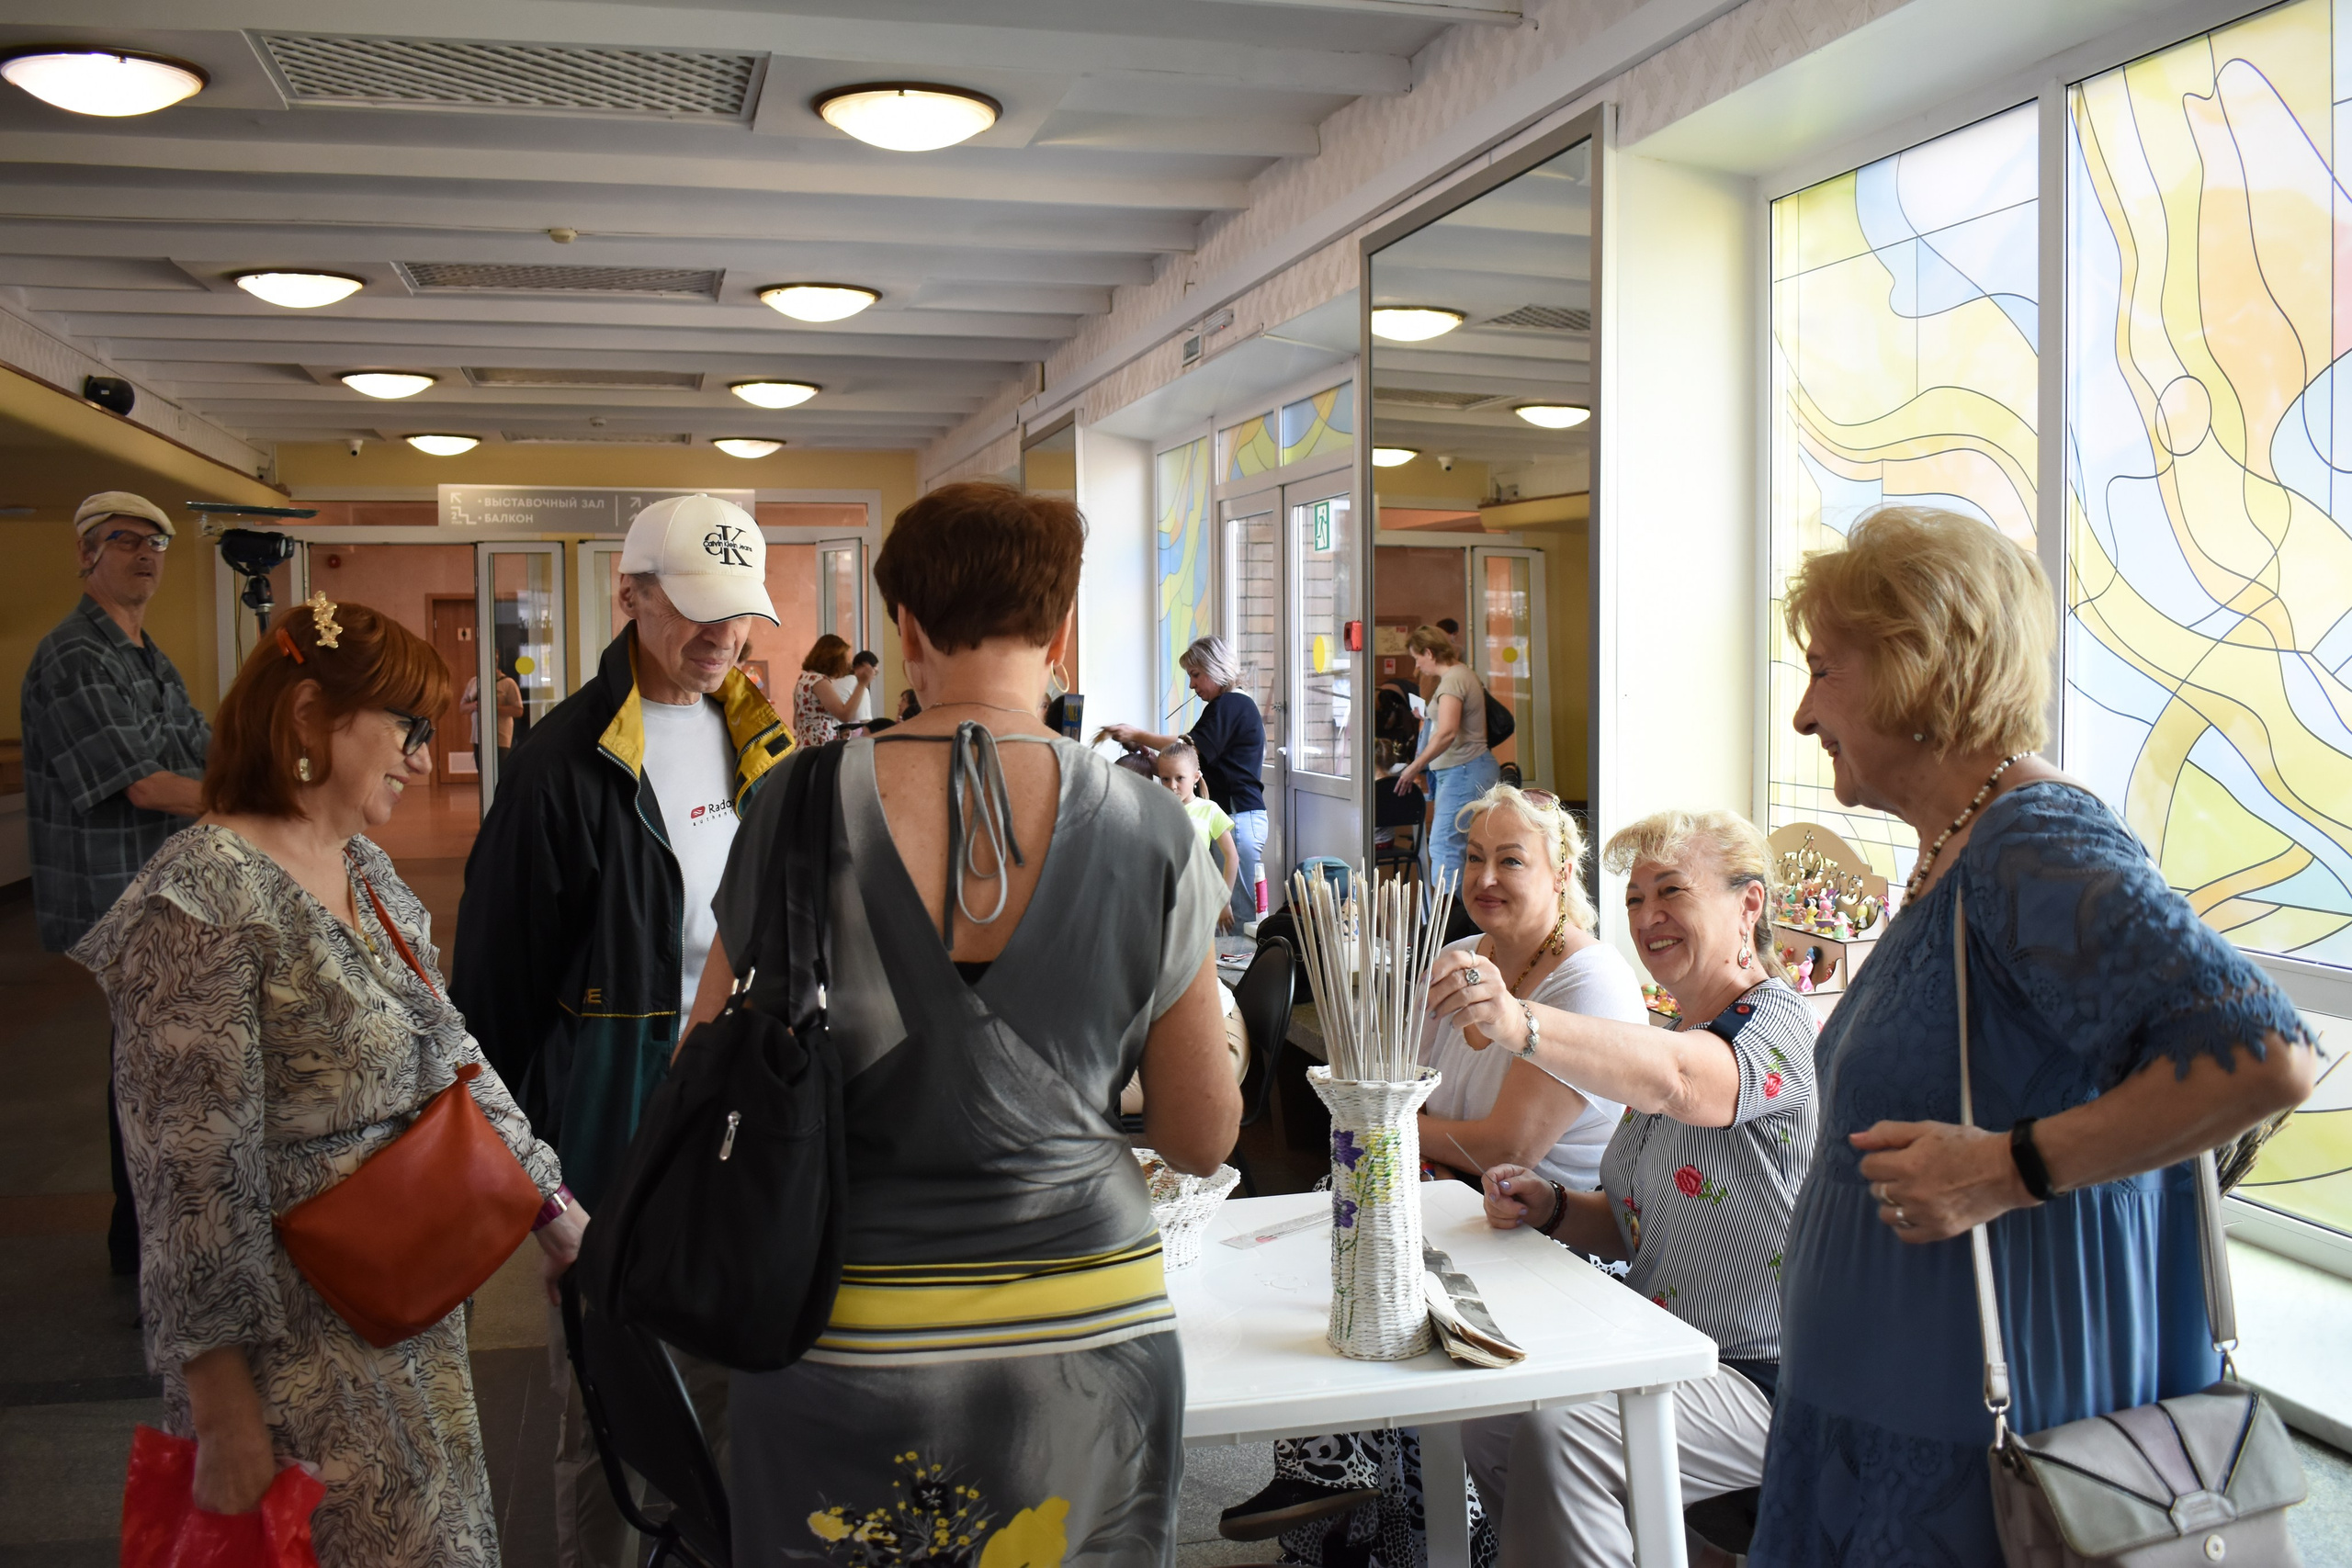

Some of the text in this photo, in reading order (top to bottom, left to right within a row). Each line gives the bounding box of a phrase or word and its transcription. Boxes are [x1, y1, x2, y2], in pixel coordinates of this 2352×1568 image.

[484, 497, 605, 508] ВЫСТАВОЧНЫЙ ЗАЛ
[484, 513, 534, 524] БАЛКОН
